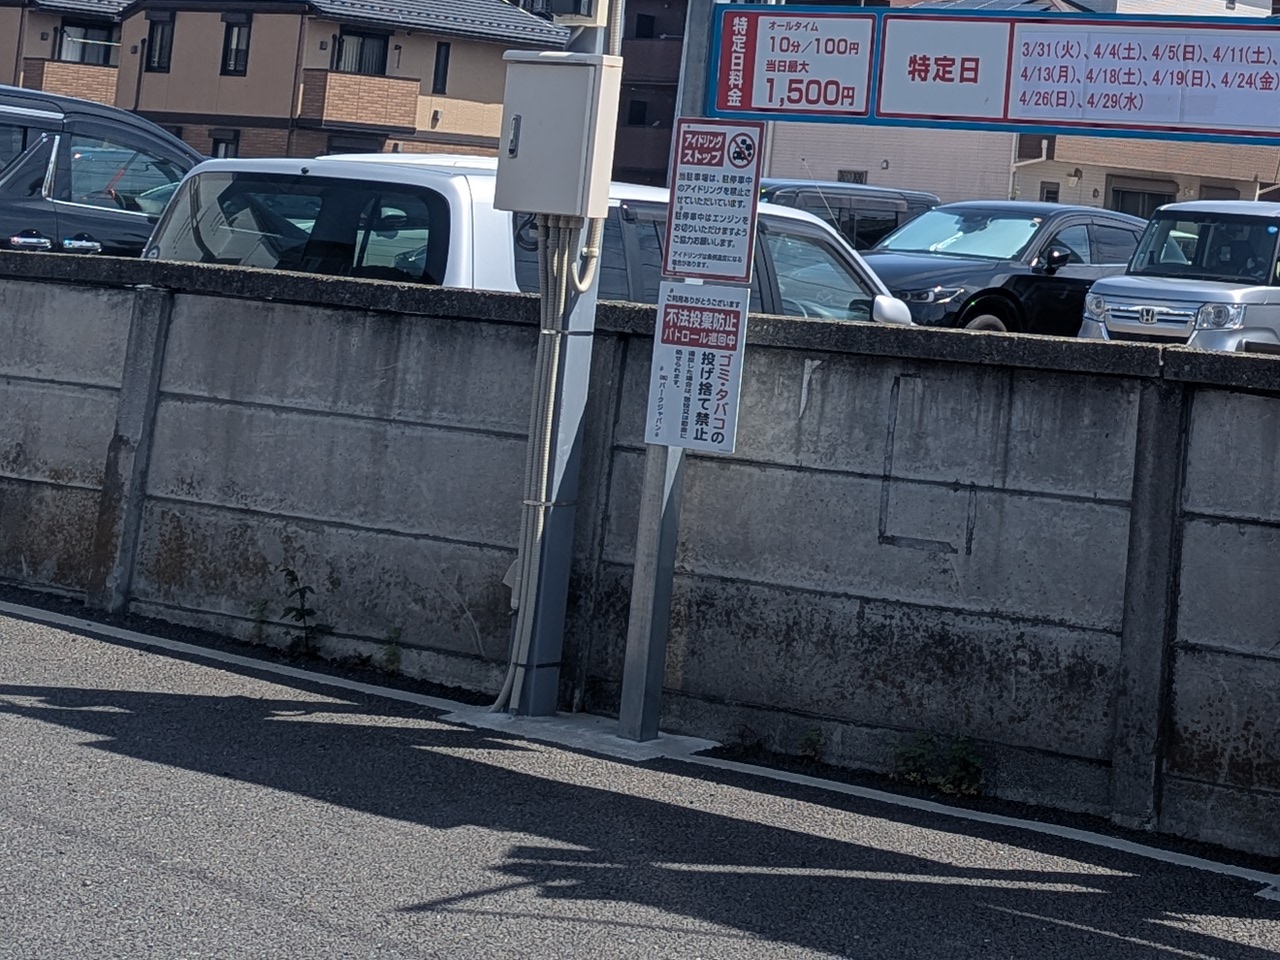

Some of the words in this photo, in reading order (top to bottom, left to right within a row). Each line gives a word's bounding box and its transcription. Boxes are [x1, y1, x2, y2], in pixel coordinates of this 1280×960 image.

[768, 21, 819, 33] オールタイム
[727, 16, 749, 107] 特定日料金
[765, 59, 810, 74] 当日最大
[908, 54, 980, 85] 特定日
[765, 77, 855, 107] 1,500円
[684, 134, 724, 149] アイドリング
[683, 149, 722, 164] ストップ
[666, 294, 741, 309] ご利用ありがとうございます
[666, 308, 738, 332] 不法投棄防止
[663, 328, 736, 347] パトロール巡回中
[693, 351, 716, 442] 投げ捨て禁止
[711, 353, 734, 445] ゴミ・タバコの
